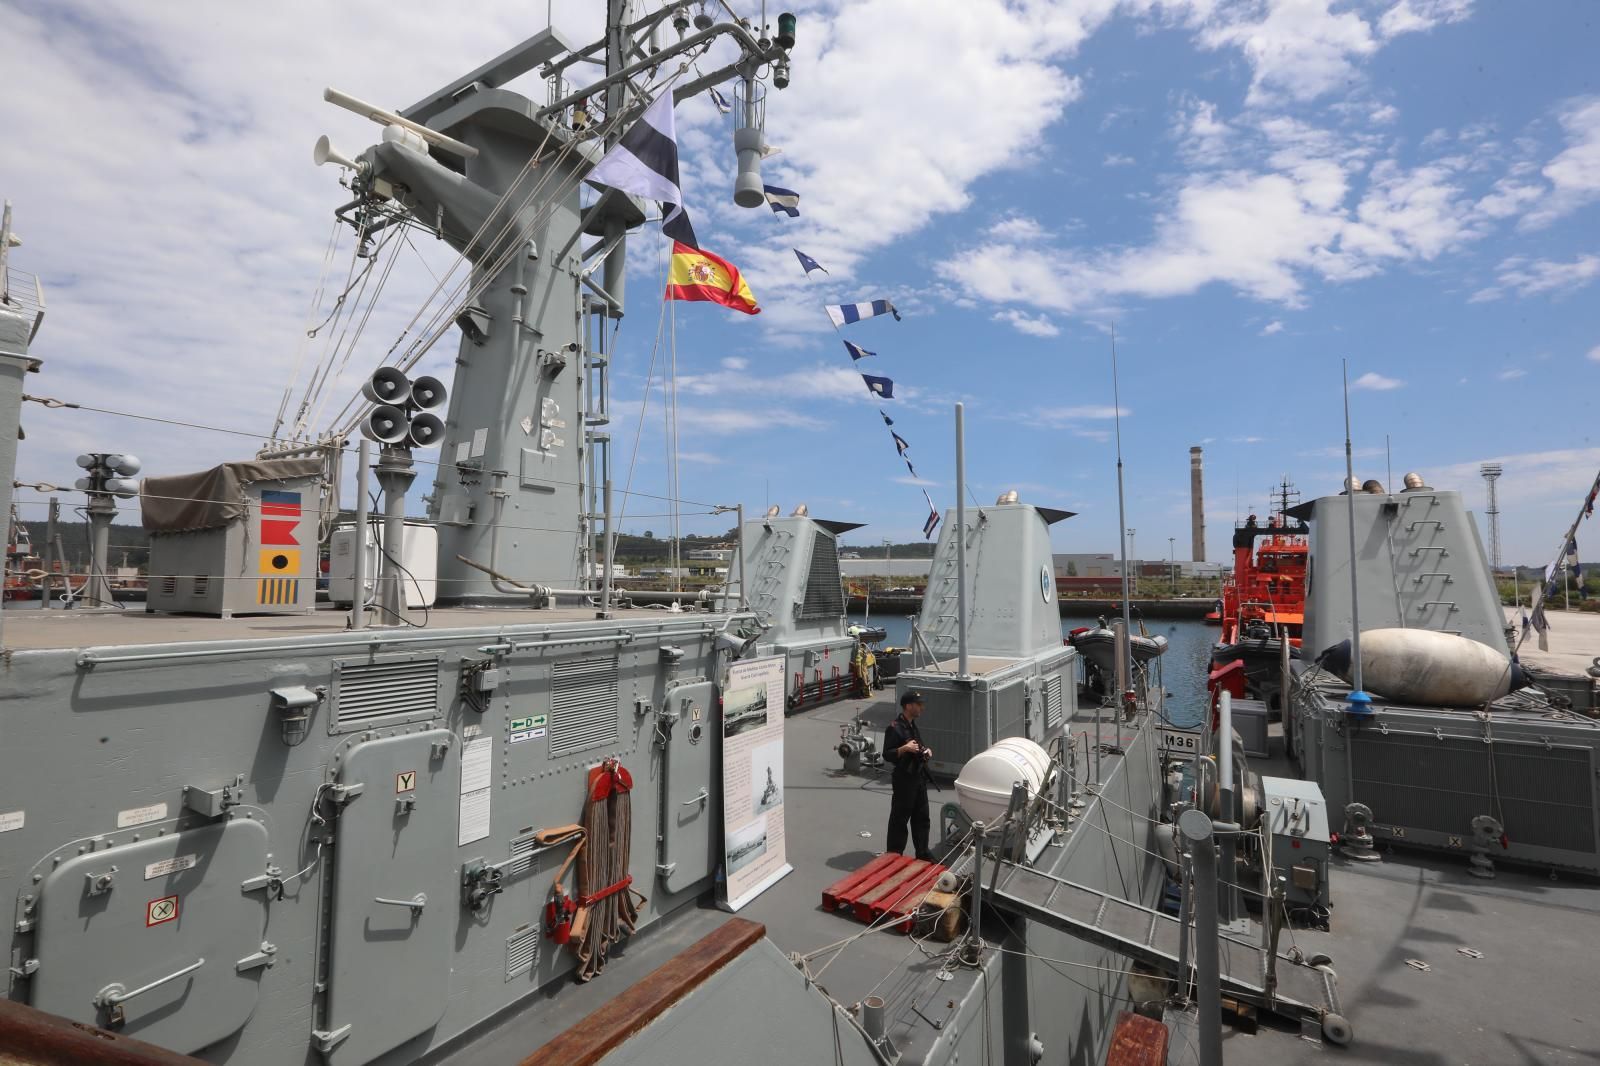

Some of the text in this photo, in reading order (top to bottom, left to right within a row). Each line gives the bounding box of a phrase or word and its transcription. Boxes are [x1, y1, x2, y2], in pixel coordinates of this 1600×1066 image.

[694, 710, 699, 719] Y
[525, 719, 532, 727] D
[401, 774, 412, 789] Y
